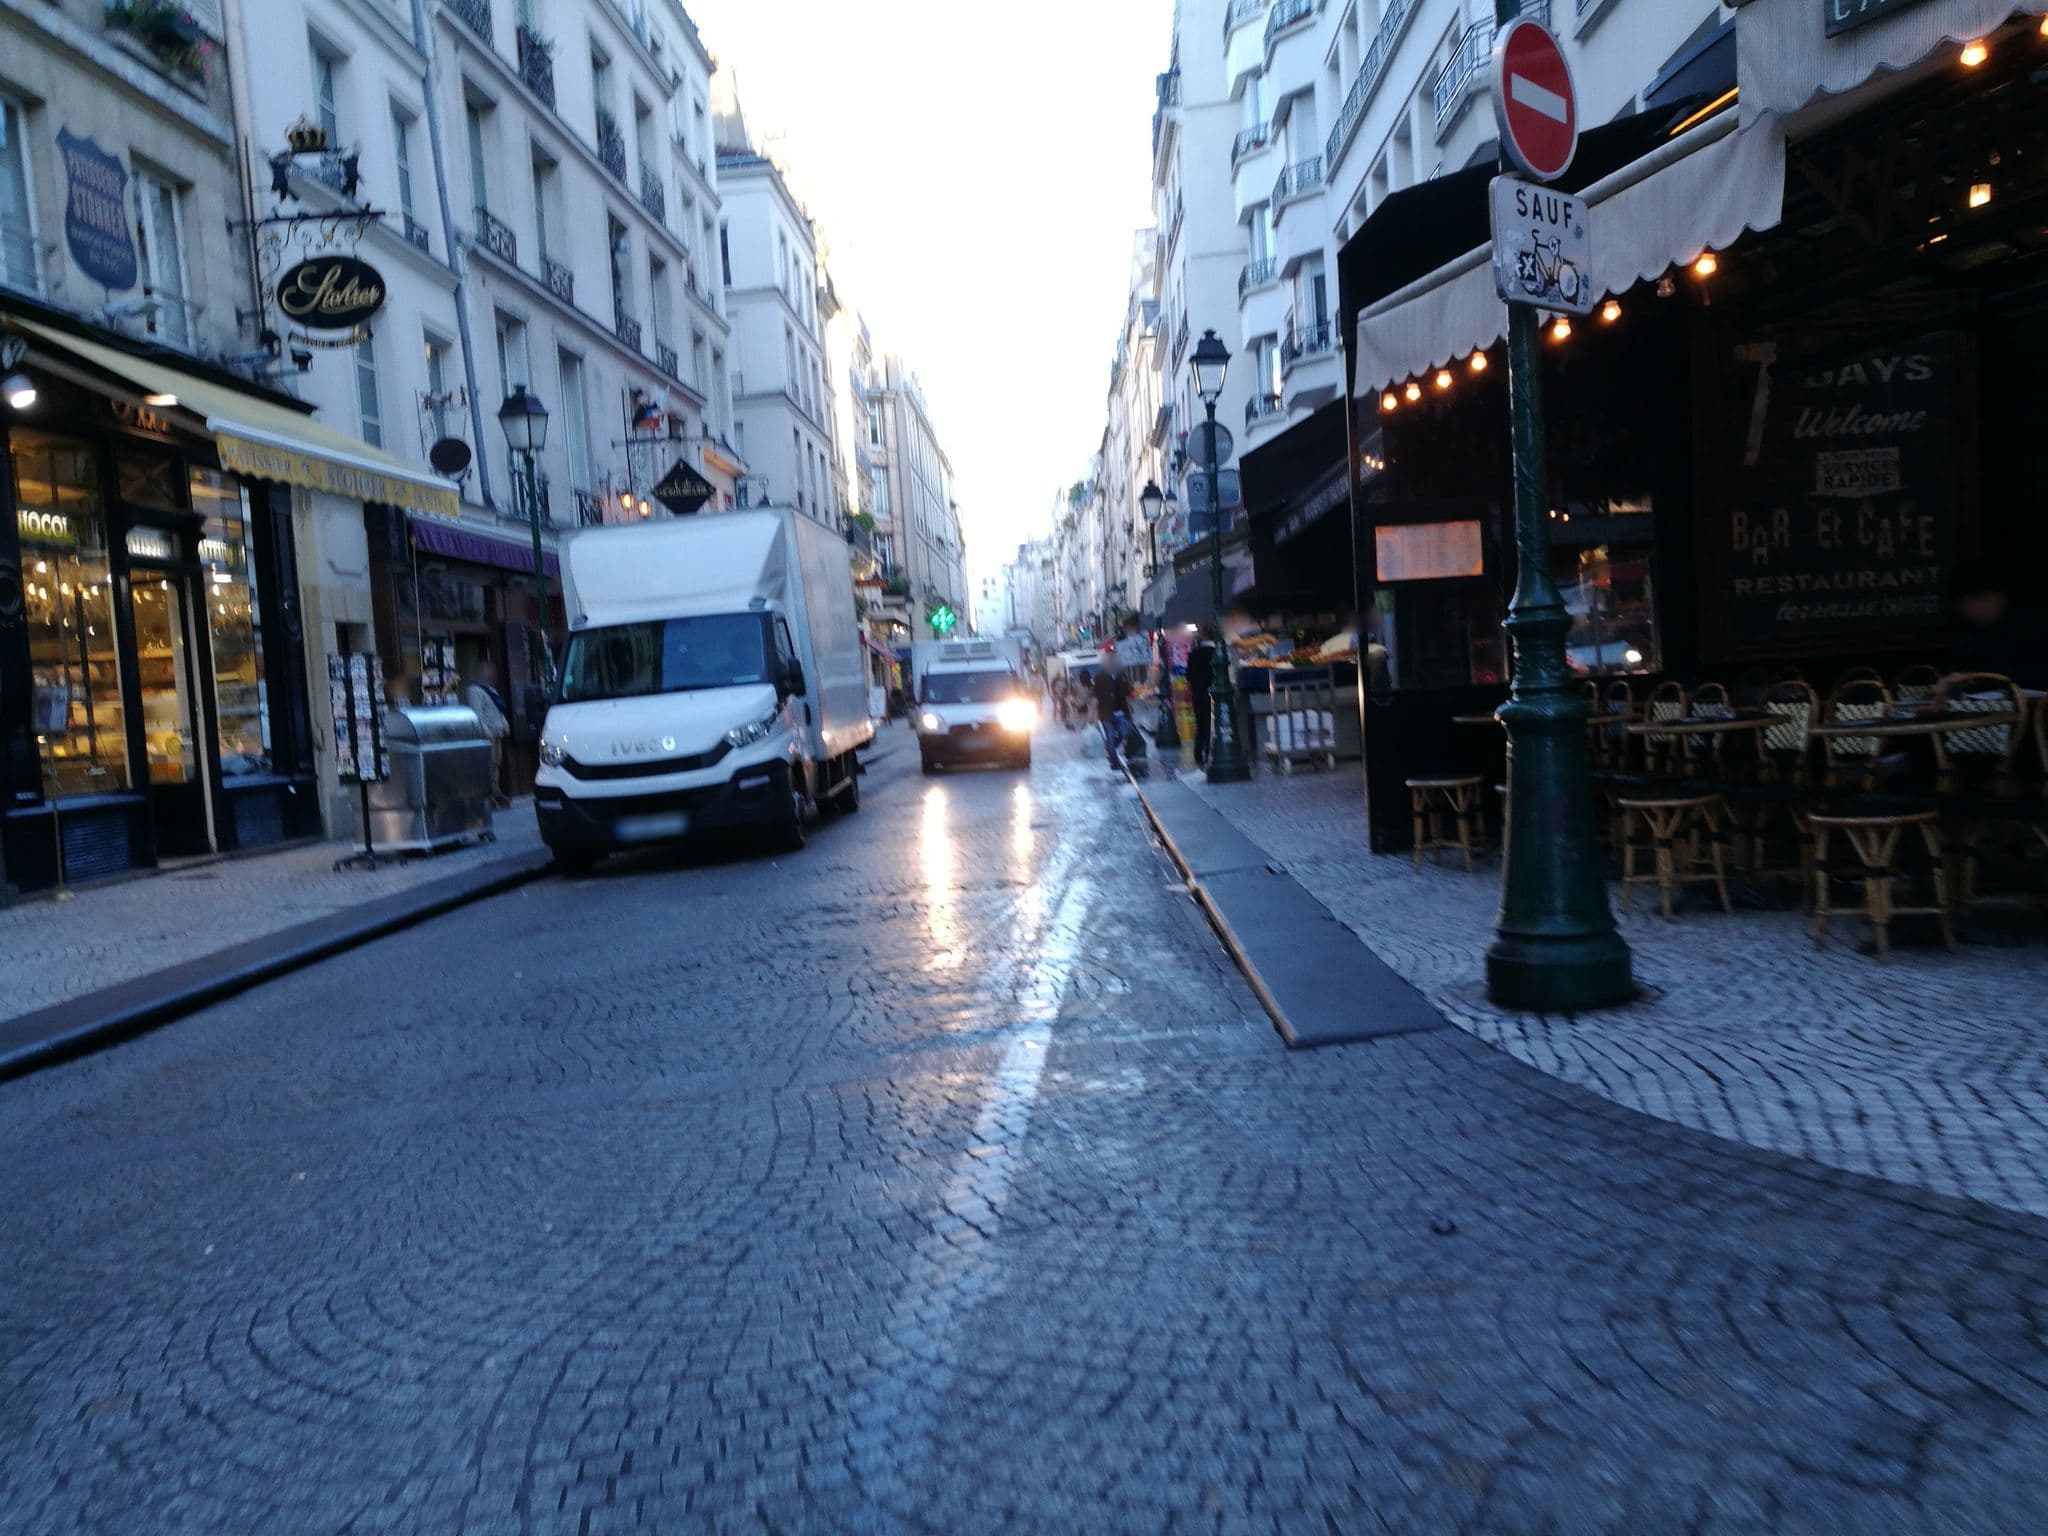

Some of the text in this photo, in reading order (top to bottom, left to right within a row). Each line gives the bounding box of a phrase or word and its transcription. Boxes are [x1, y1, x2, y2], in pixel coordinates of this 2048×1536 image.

[1516, 188, 1573, 228] SAUF
[1731, 341, 1776, 467] 7
[1792, 402, 1928, 440] Welcome
[1824, 472, 1893, 490] RAPIDE
[1736, 566, 1942, 596] RESTAURANT
[612, 736, 677, 757] IVECO
